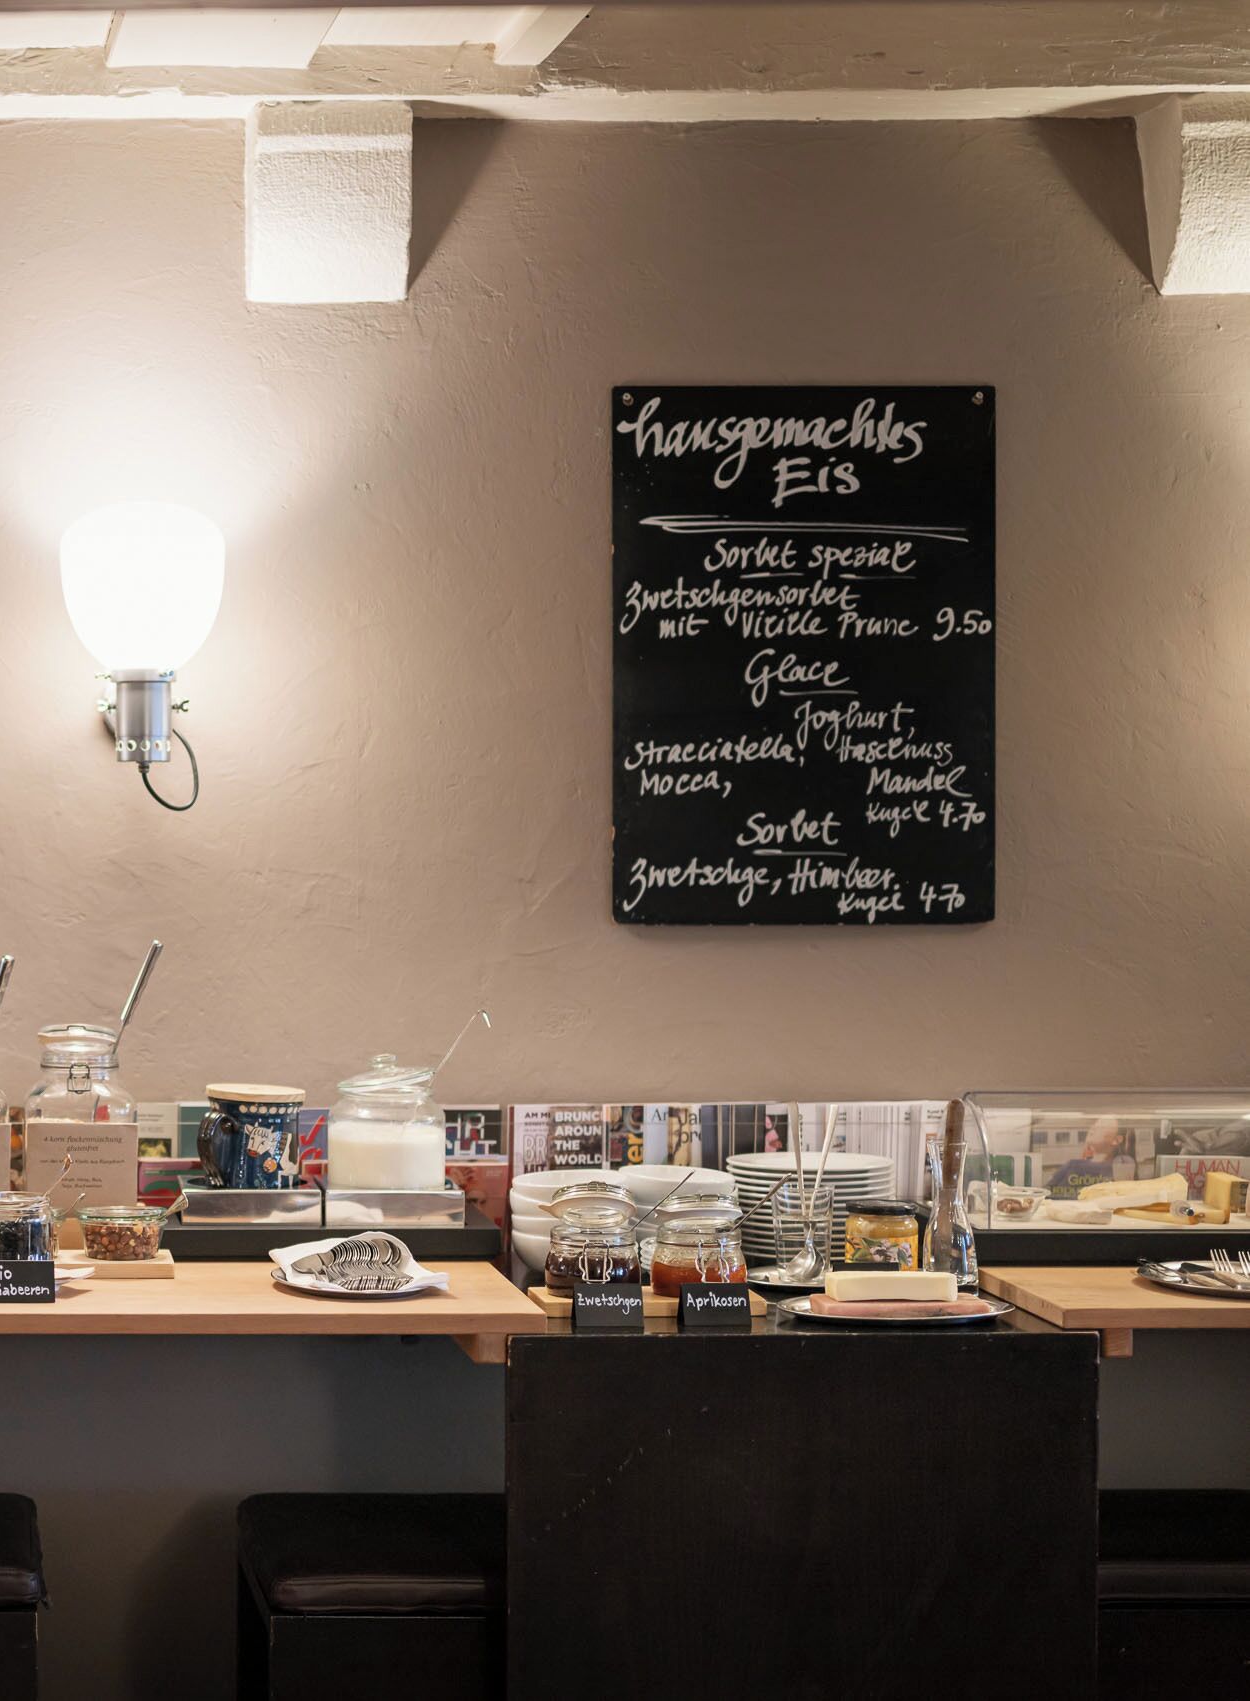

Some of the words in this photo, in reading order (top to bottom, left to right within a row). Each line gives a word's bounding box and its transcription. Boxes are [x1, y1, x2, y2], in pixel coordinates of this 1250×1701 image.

[616, 396, 928, 489] hausgemachtes
[770, 456, 861, 509] Eis
[704, 536, 797, 573] Sorbet
[808, 541, 917, 580] spezial
[658, 613, 710, 640] mit
[837, 612, 919, 640] Prune
[932, 606, 993, 642] 9.50
[744, 648, 850, 708] Glace
[639, 768, 733, 799] Mocca,
[866, 765, 973, 798] Mandel
[736, 808, 841, 846] Sorbet
[865, 800, 931, 838] Kugel
[938, 801, 987, 832] 4.70
[837, 892, 905, 924] Kugel
[555, 1111, 602, 1122] BRUNC
[555, 1126, 602, 1137] AROUN
[554, 1140, 580, 1151] THE
[554, 1154, 602, 1165] WORLD
[577, 1292, 642, 1315] Zwetschgen
[686, 1291, 747, 1311] Aprikosen
